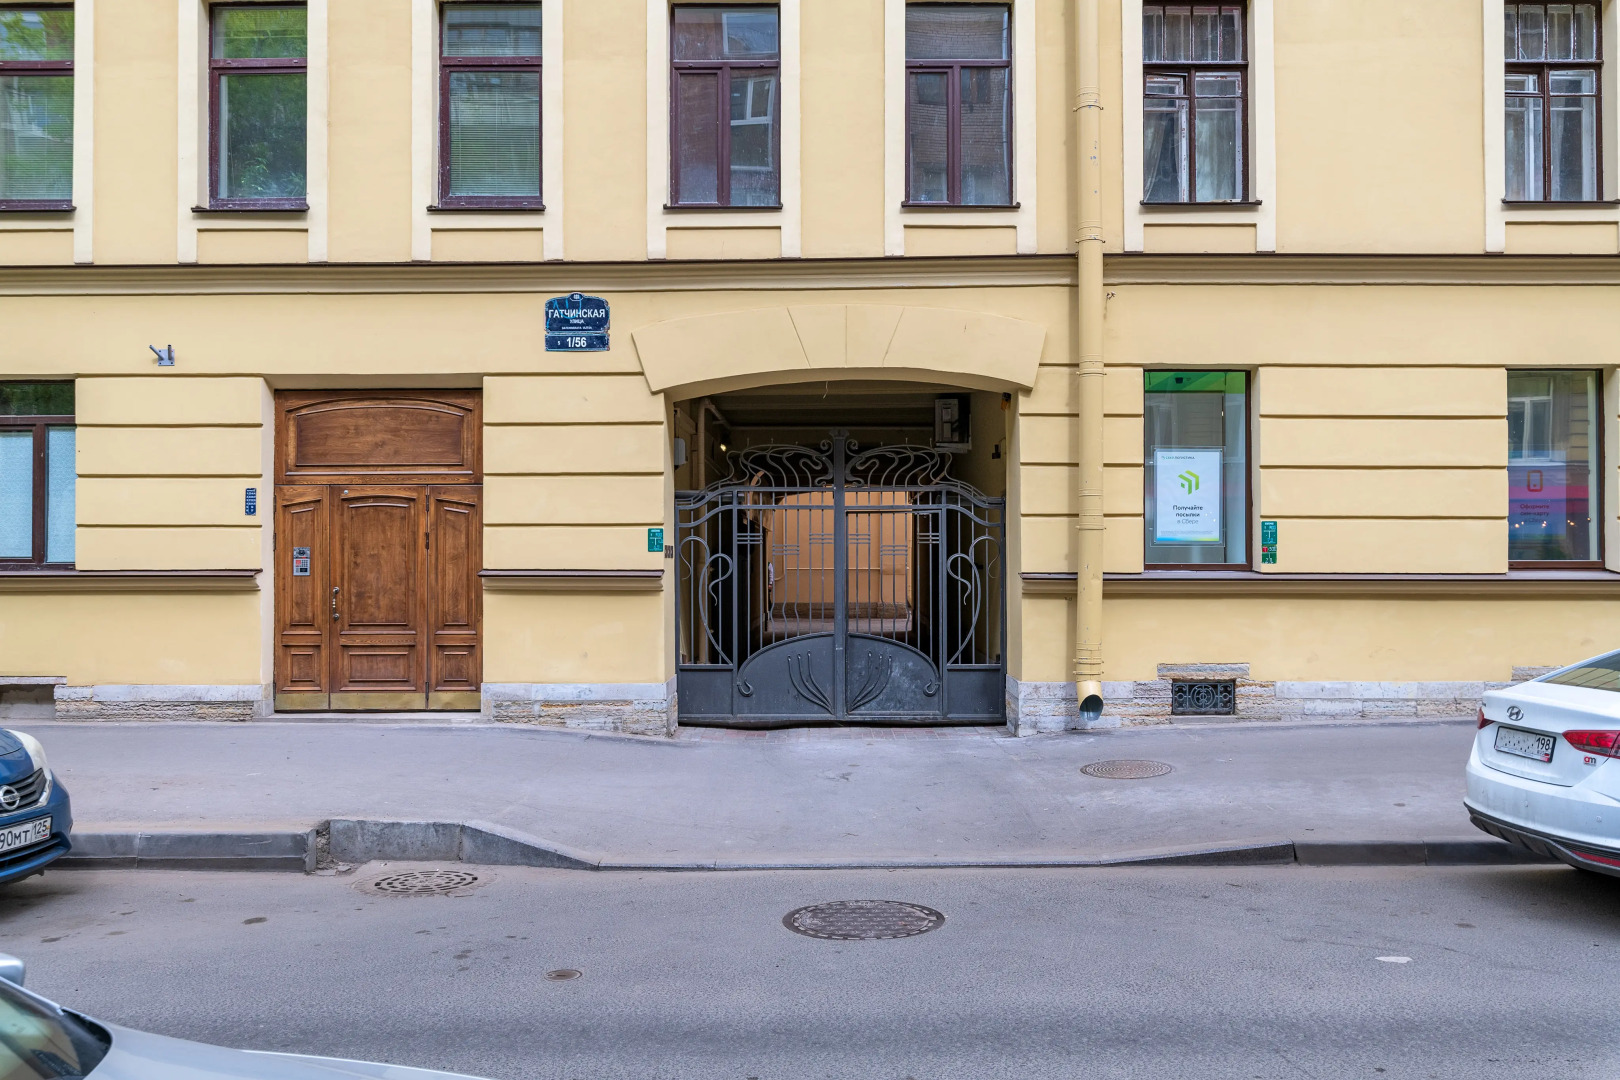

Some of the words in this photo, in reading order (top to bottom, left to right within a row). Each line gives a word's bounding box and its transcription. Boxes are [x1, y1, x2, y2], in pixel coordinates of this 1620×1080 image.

[548, 309, 606, 318] ГАТЧИНСКАЯ
[566, 337, 586, 347] 1/56
[1536, 737, 1550, 750] 198
[34, 820, 48, 835] 125
